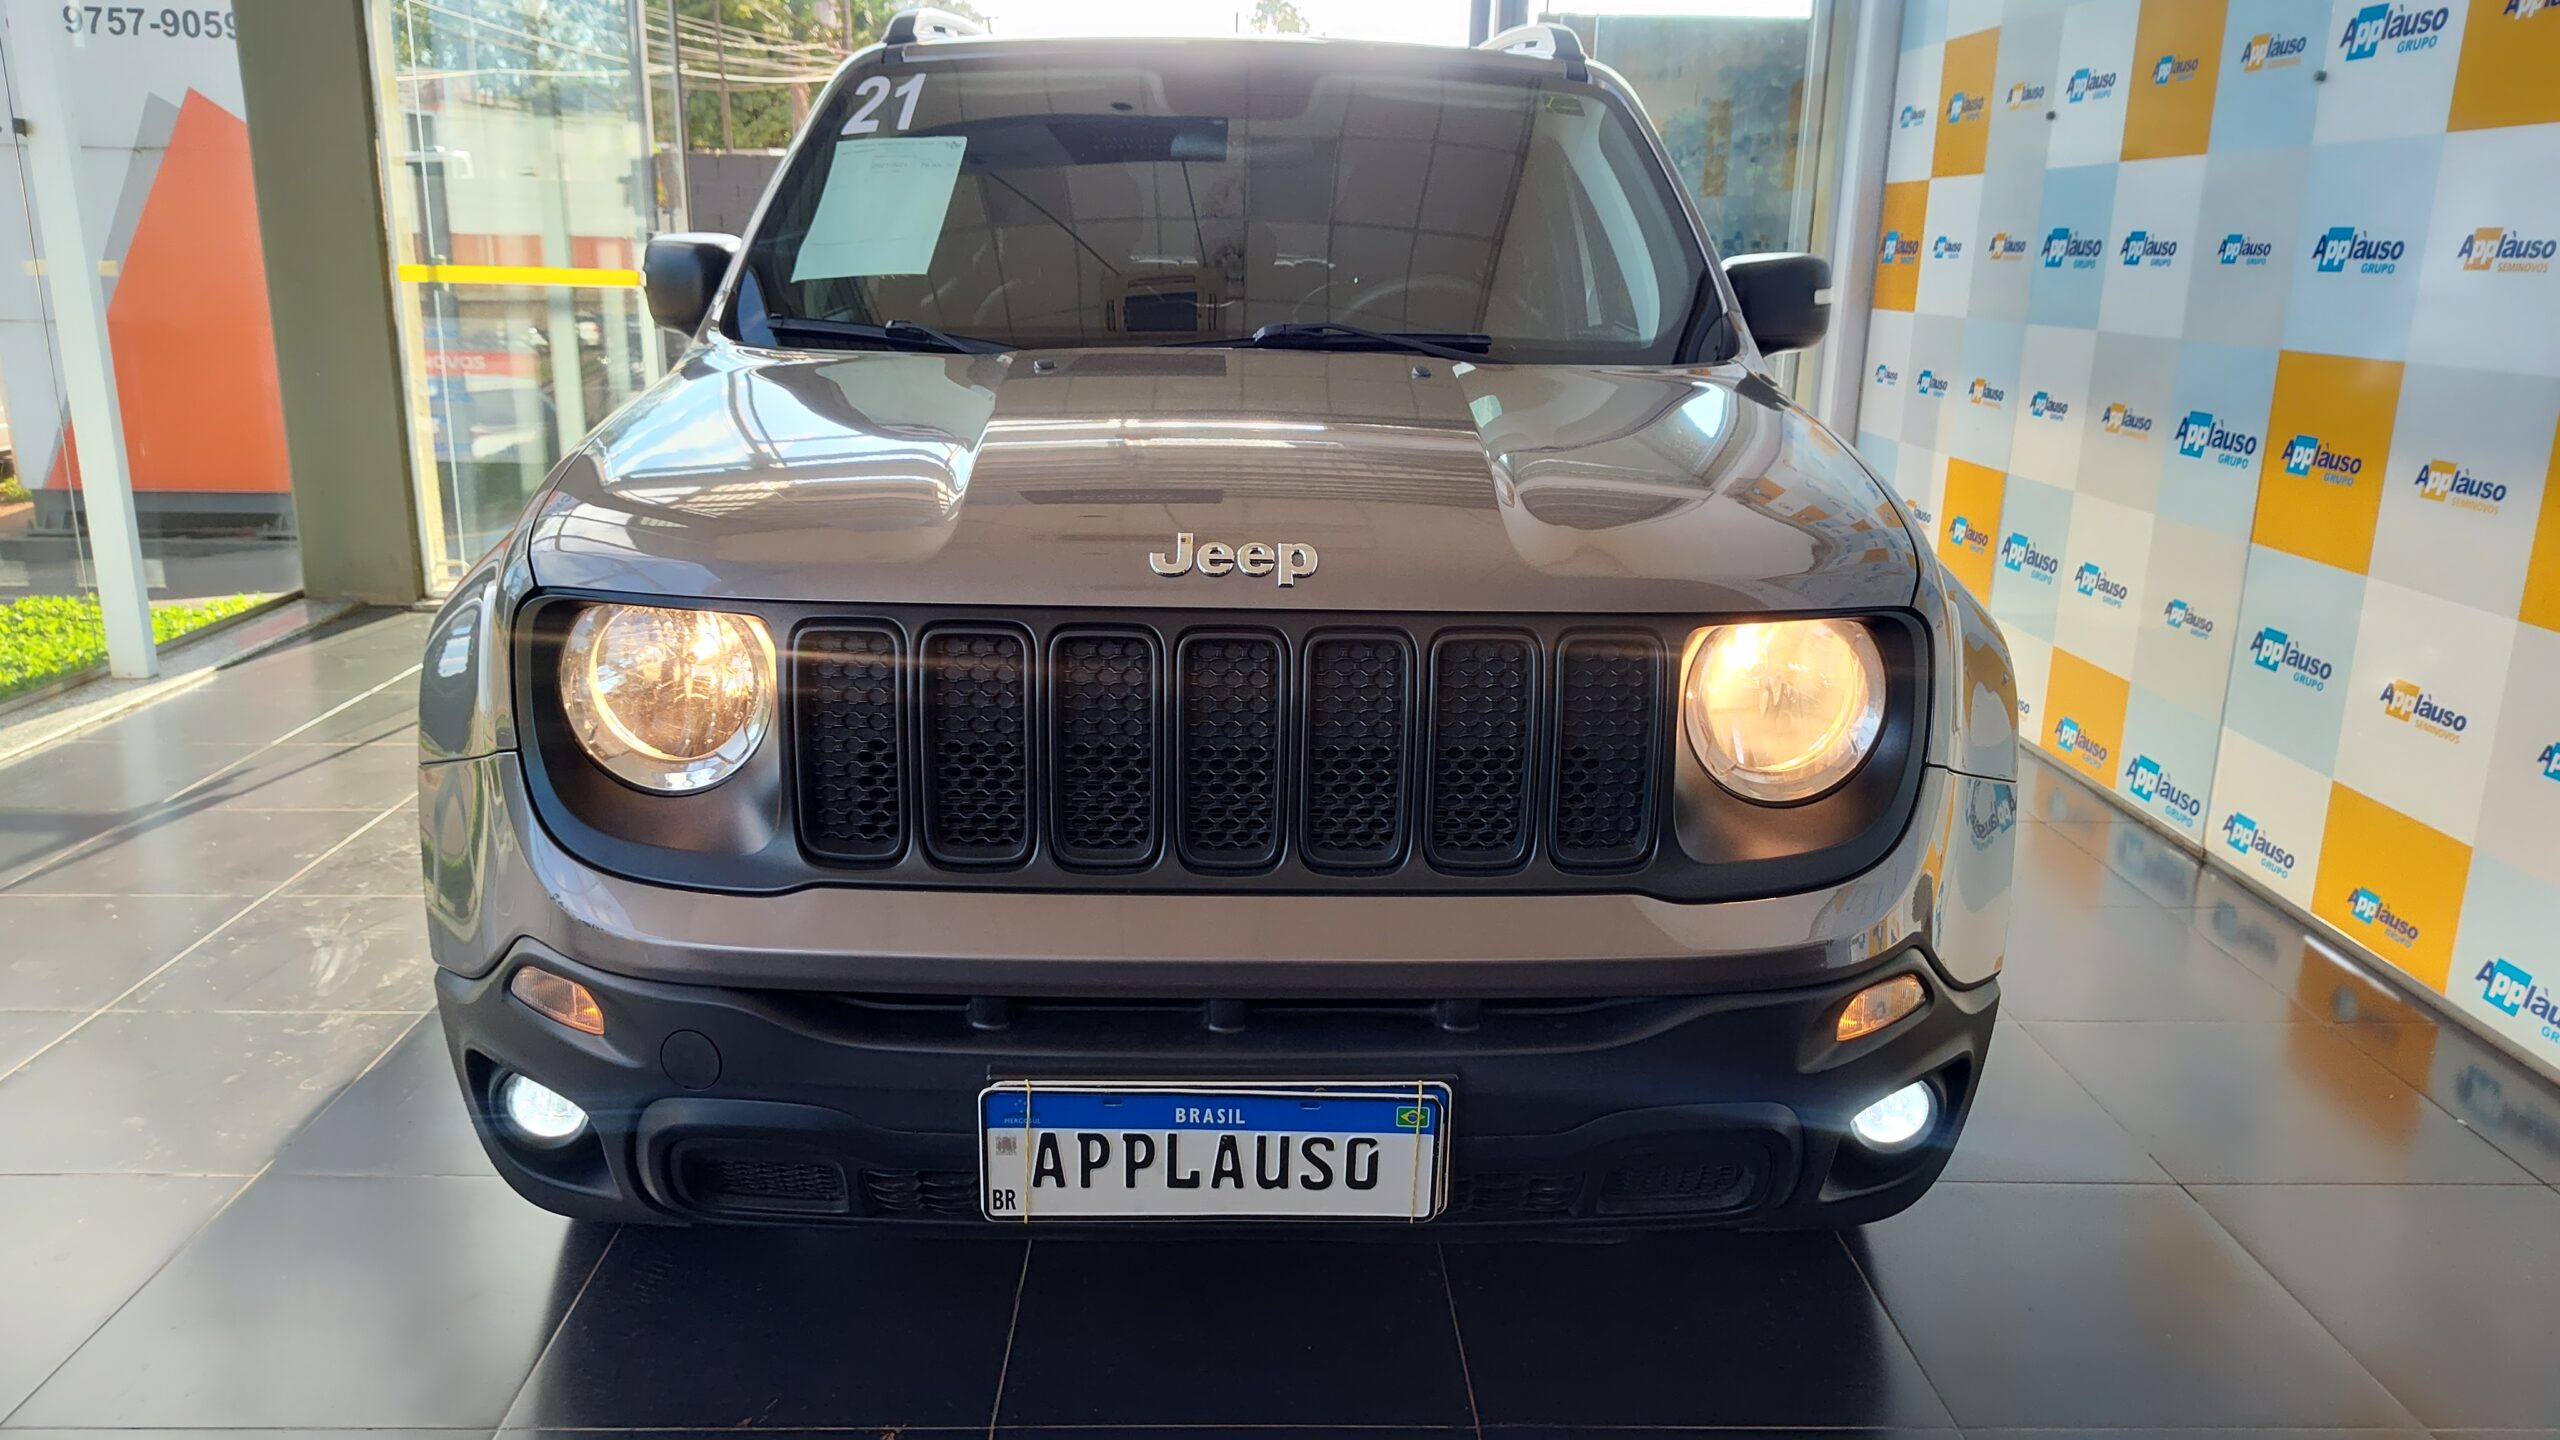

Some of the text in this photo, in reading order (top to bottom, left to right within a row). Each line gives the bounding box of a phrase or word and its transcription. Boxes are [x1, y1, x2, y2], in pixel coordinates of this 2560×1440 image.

[2396, 35, 2438, 54] GRUPO
[841, 73, 926, 135] 21
[2361, 262, 2395, 274] GRUPO
[2497, 262, 2549, 273] SEMINOVOS
[2217, 453, 2249, 470] GRUPO
[2323, 471, 2354, 487] GRUPO
[1150, 533, 1318, 588] Jeep
[2293, 672, 2324, 692] GRUPO
[2259, 857, 2288, 879] GRUPO
[1175, 1107, 1246, 1125] BRASIL
[1032, 1131, 1380, 1191] APPLAUSO
[993, 1189, 1016, 1210] BR
